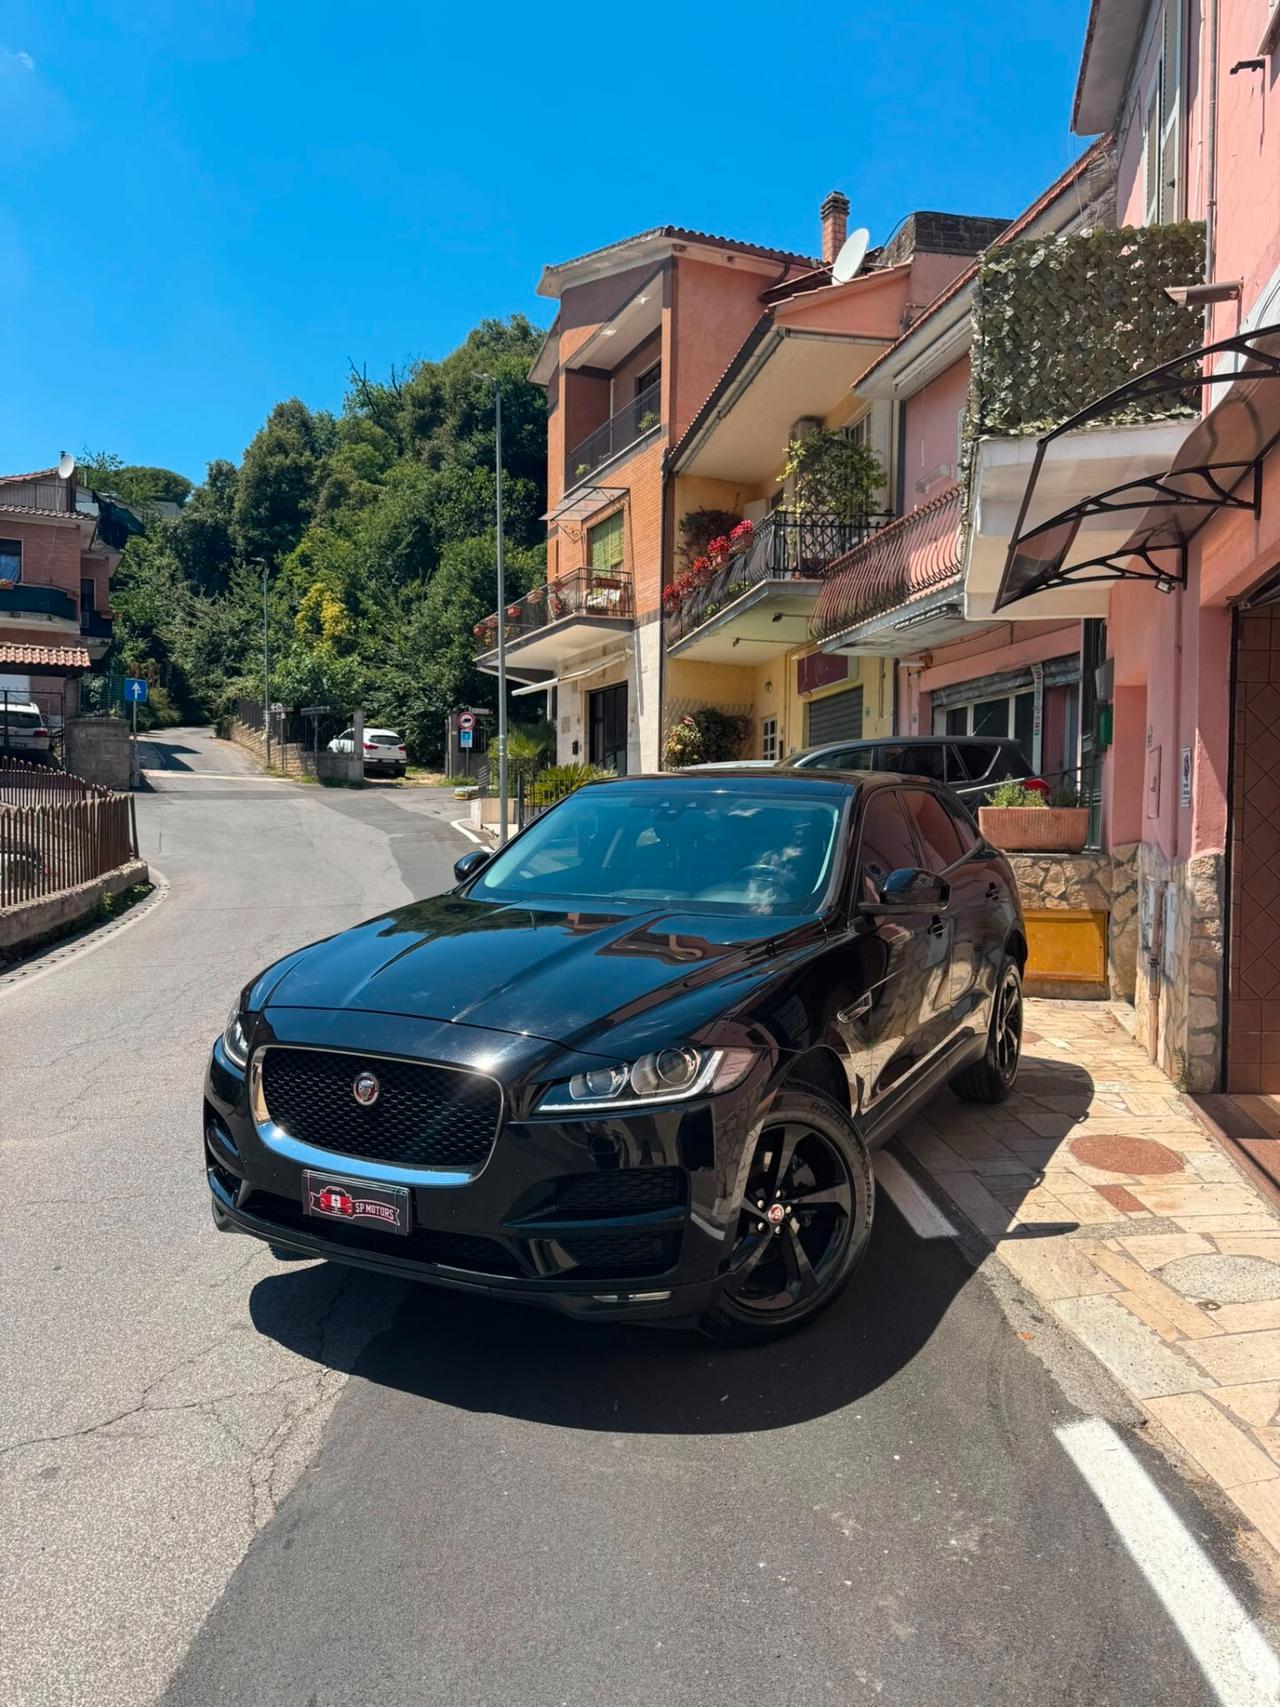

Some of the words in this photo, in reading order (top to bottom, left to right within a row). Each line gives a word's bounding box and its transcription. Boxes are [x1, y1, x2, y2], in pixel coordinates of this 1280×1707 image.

[810, 1101, 847, 1129] ROYAL
[355, 1202, 364, 1213] SP
[365, 1203, 394, 1220] MOTORS
